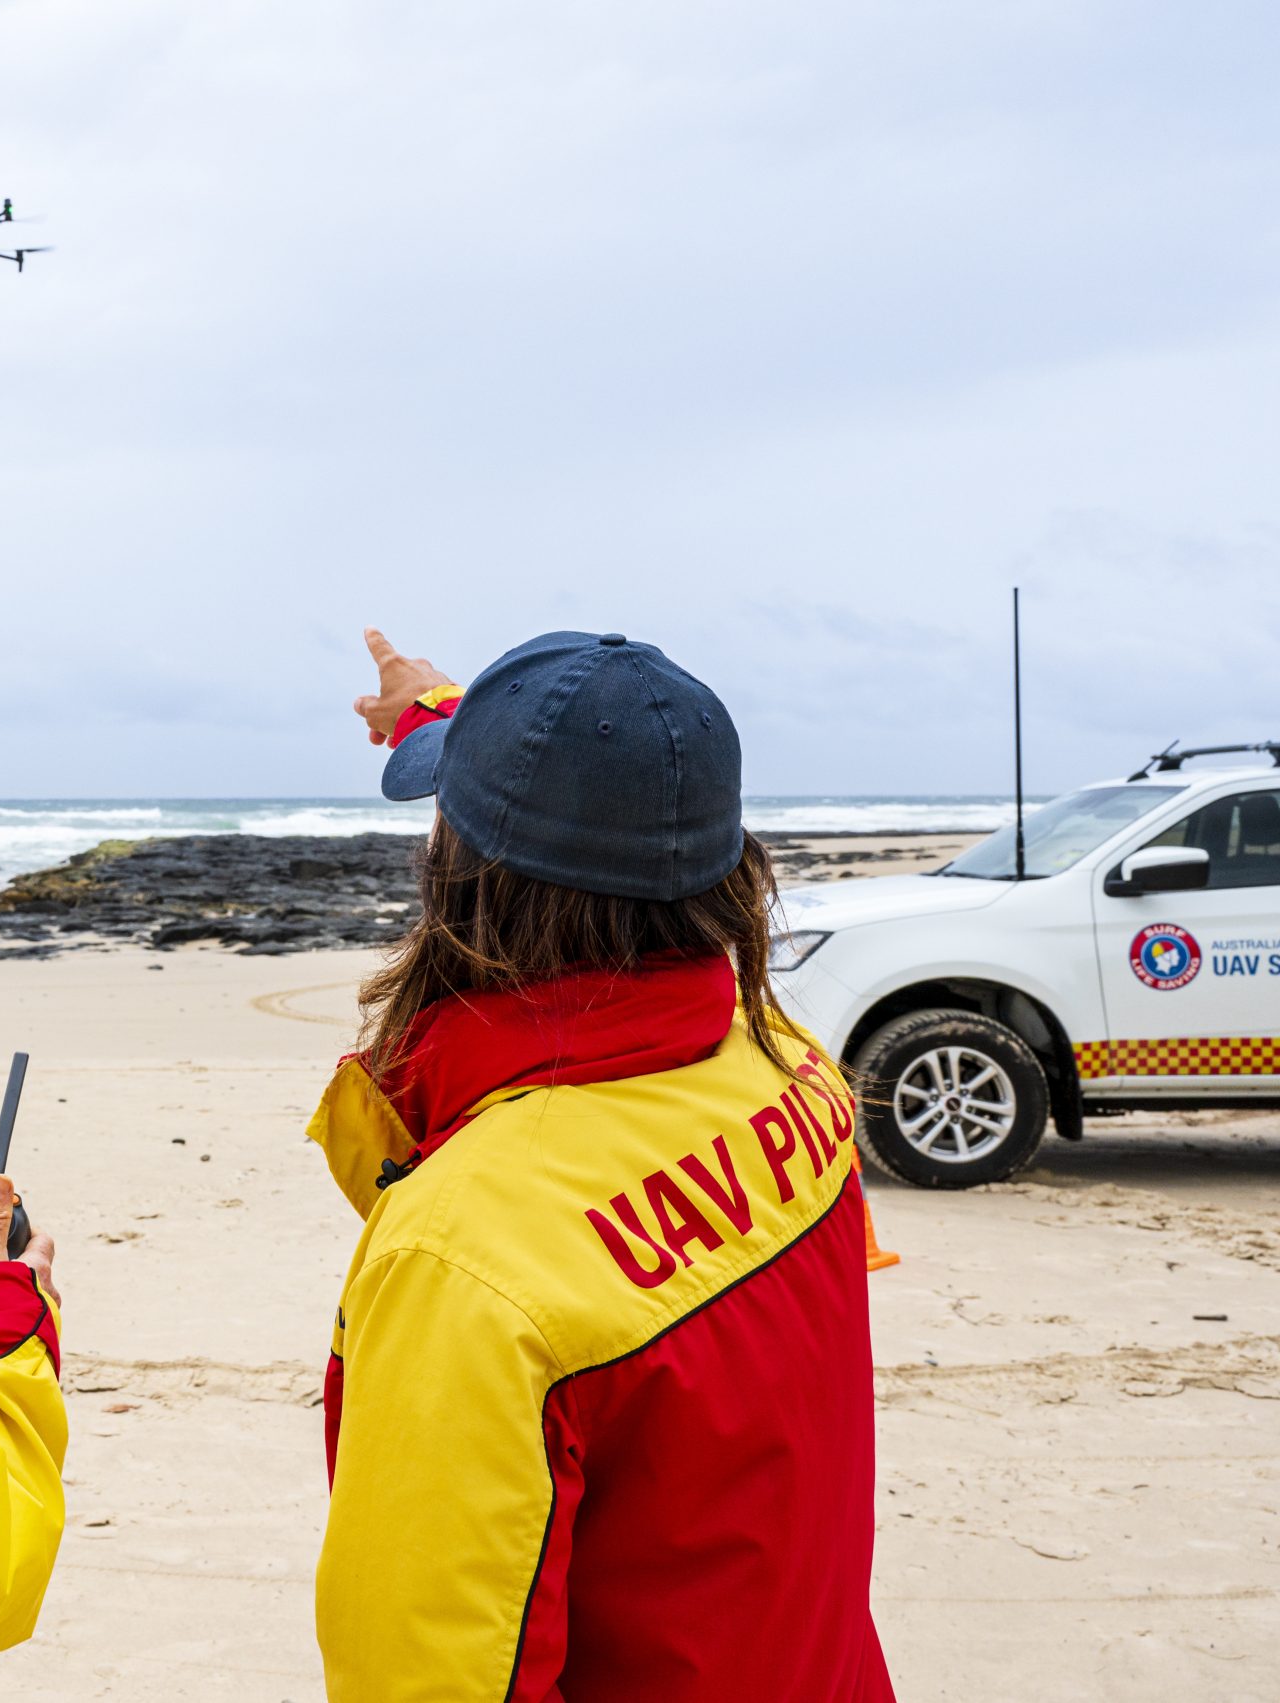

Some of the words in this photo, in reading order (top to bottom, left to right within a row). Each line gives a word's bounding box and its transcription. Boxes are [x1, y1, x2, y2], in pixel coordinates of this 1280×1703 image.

[1143, 925, 1187, 938] SURF
[1131, 958, 1155, 986] LIFE
[1157, 957, 1200, 989] SAVING
[1213, 955, 1259, 976] UAV
[584, 1134, 754, 1289] UAV
